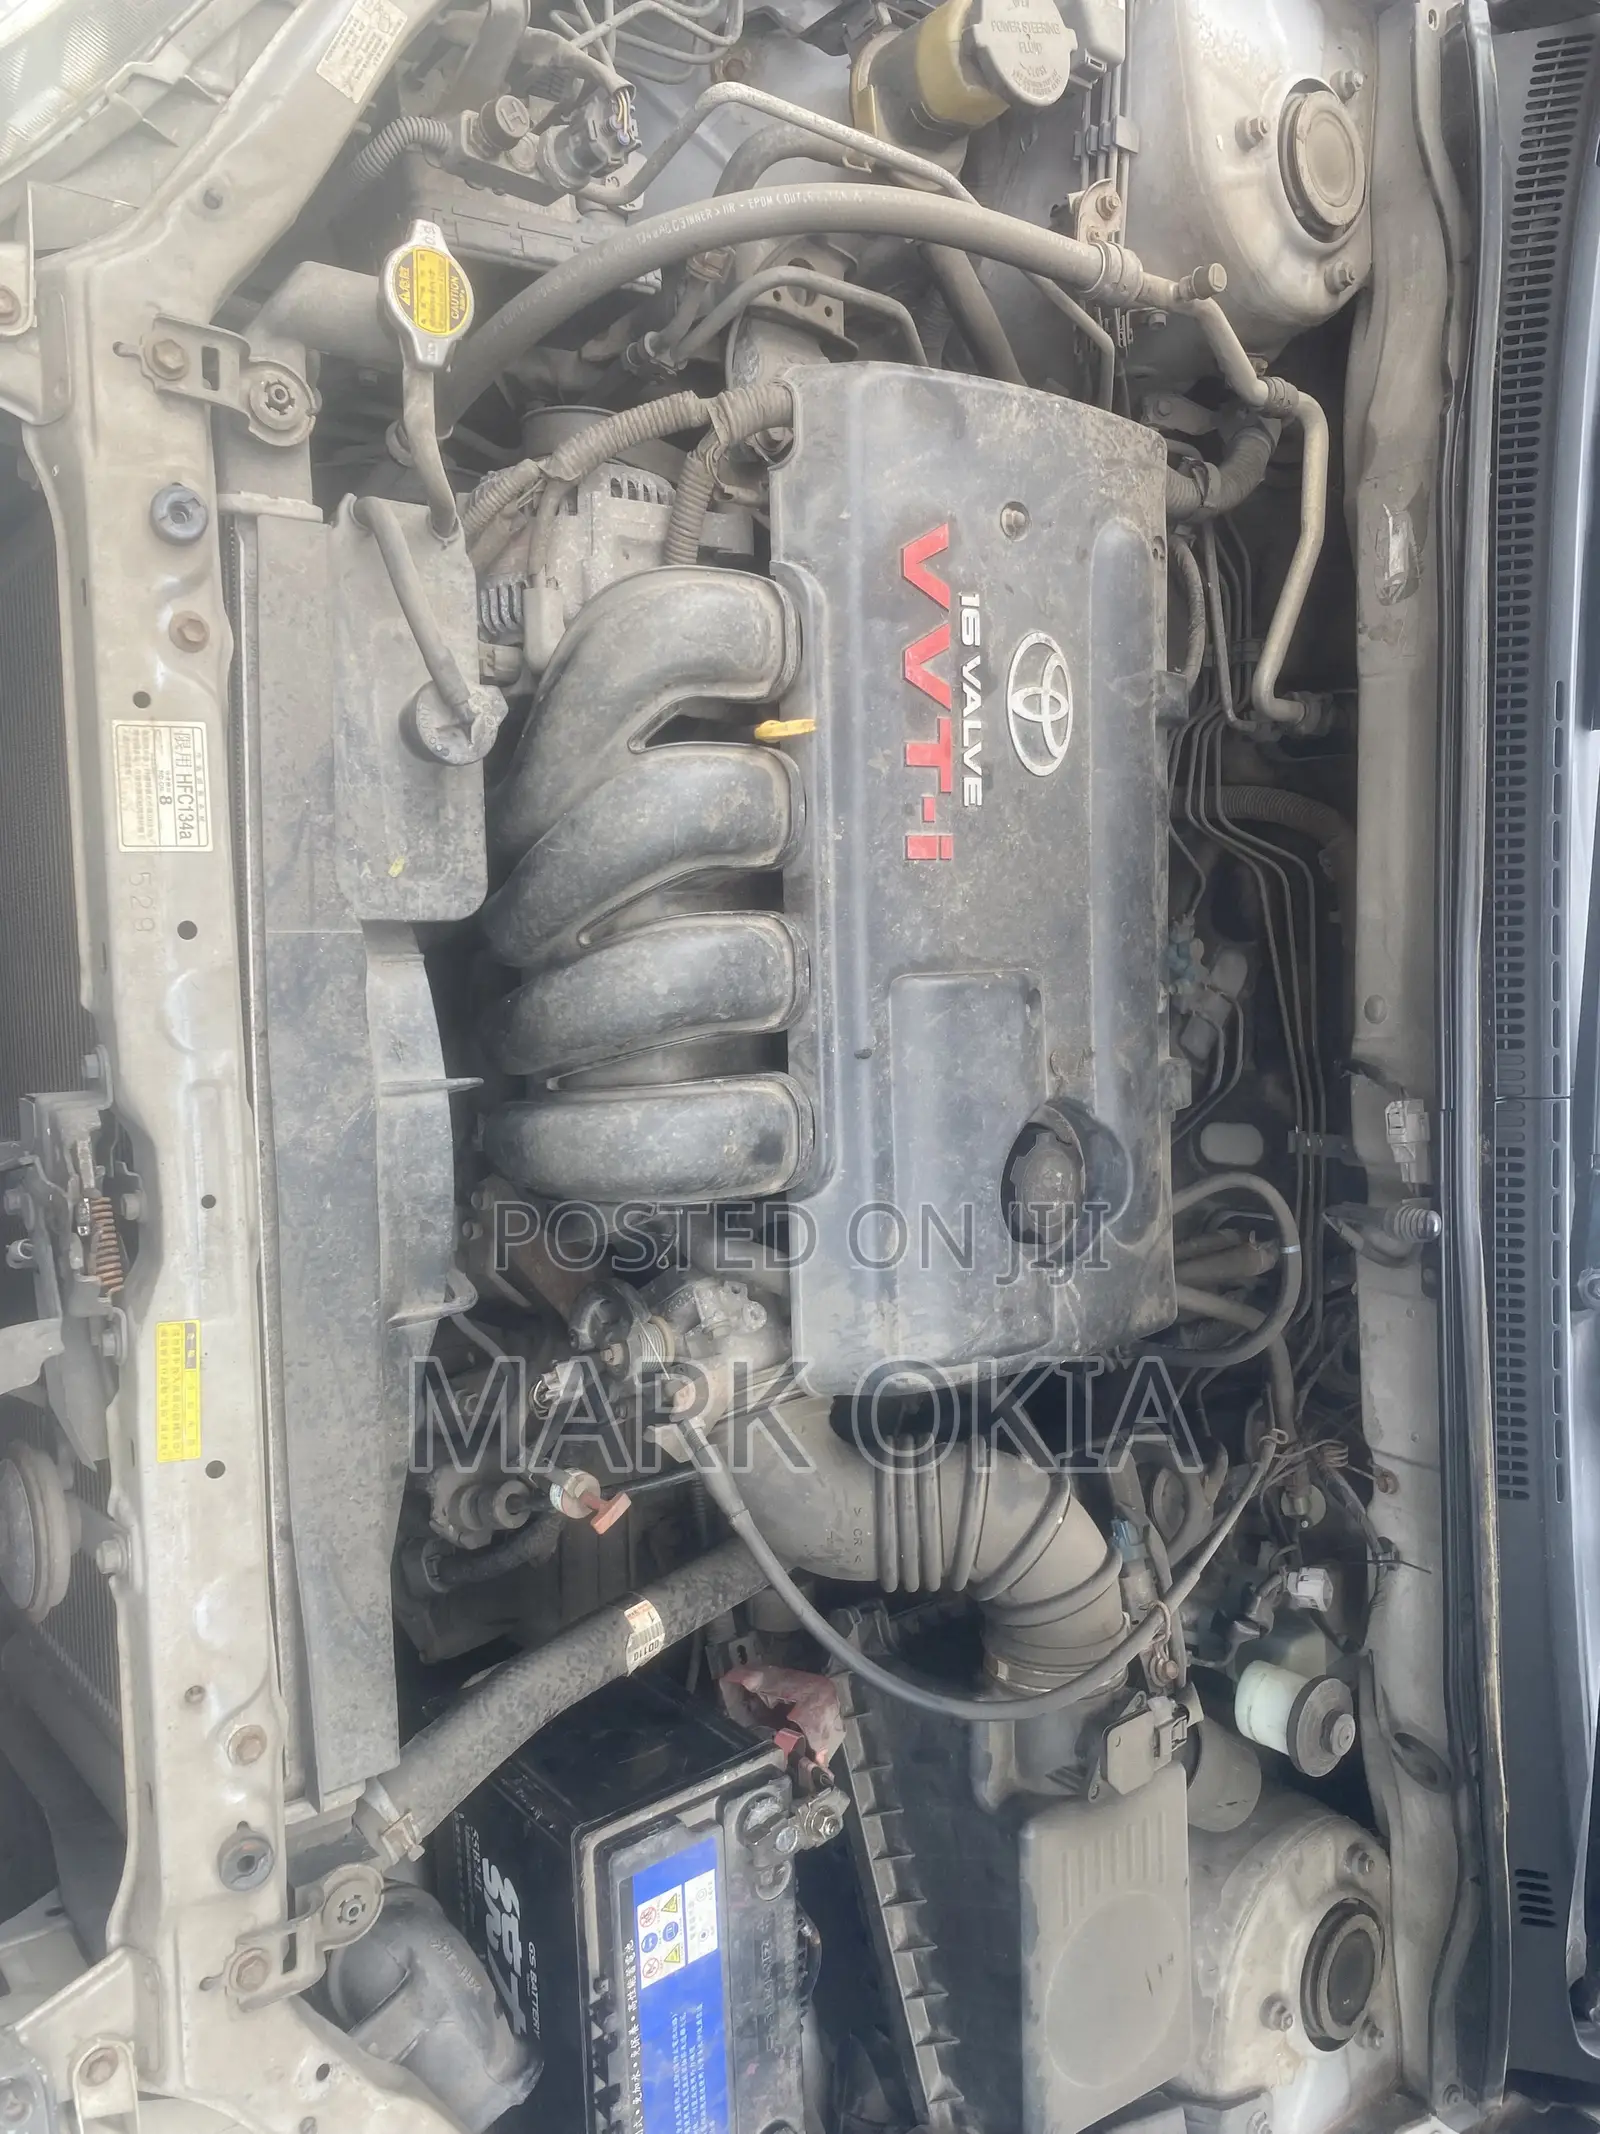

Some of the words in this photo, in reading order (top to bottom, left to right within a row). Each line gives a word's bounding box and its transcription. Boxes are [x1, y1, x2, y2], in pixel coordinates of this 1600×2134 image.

[991, 20, 1022, 32] POWER
[1022, 22, 1060, 34] STEERING
[1019, 42, 1042, 54] FLUID
[748, 194, 773, 210] EPDM
[450, 275, 460, 320] CAUTION
[957, 591, 981, 647] 16
[903, 523, 953, 861] VVT-i
[961, 655, 983, 807] VALVE
[159, 795, 173, 805] 8
[176, 773, 195, 840] HFC134a
[528, 1941, 537, 1970] GS
[530, 1971, 541, 2040] BATTERY
